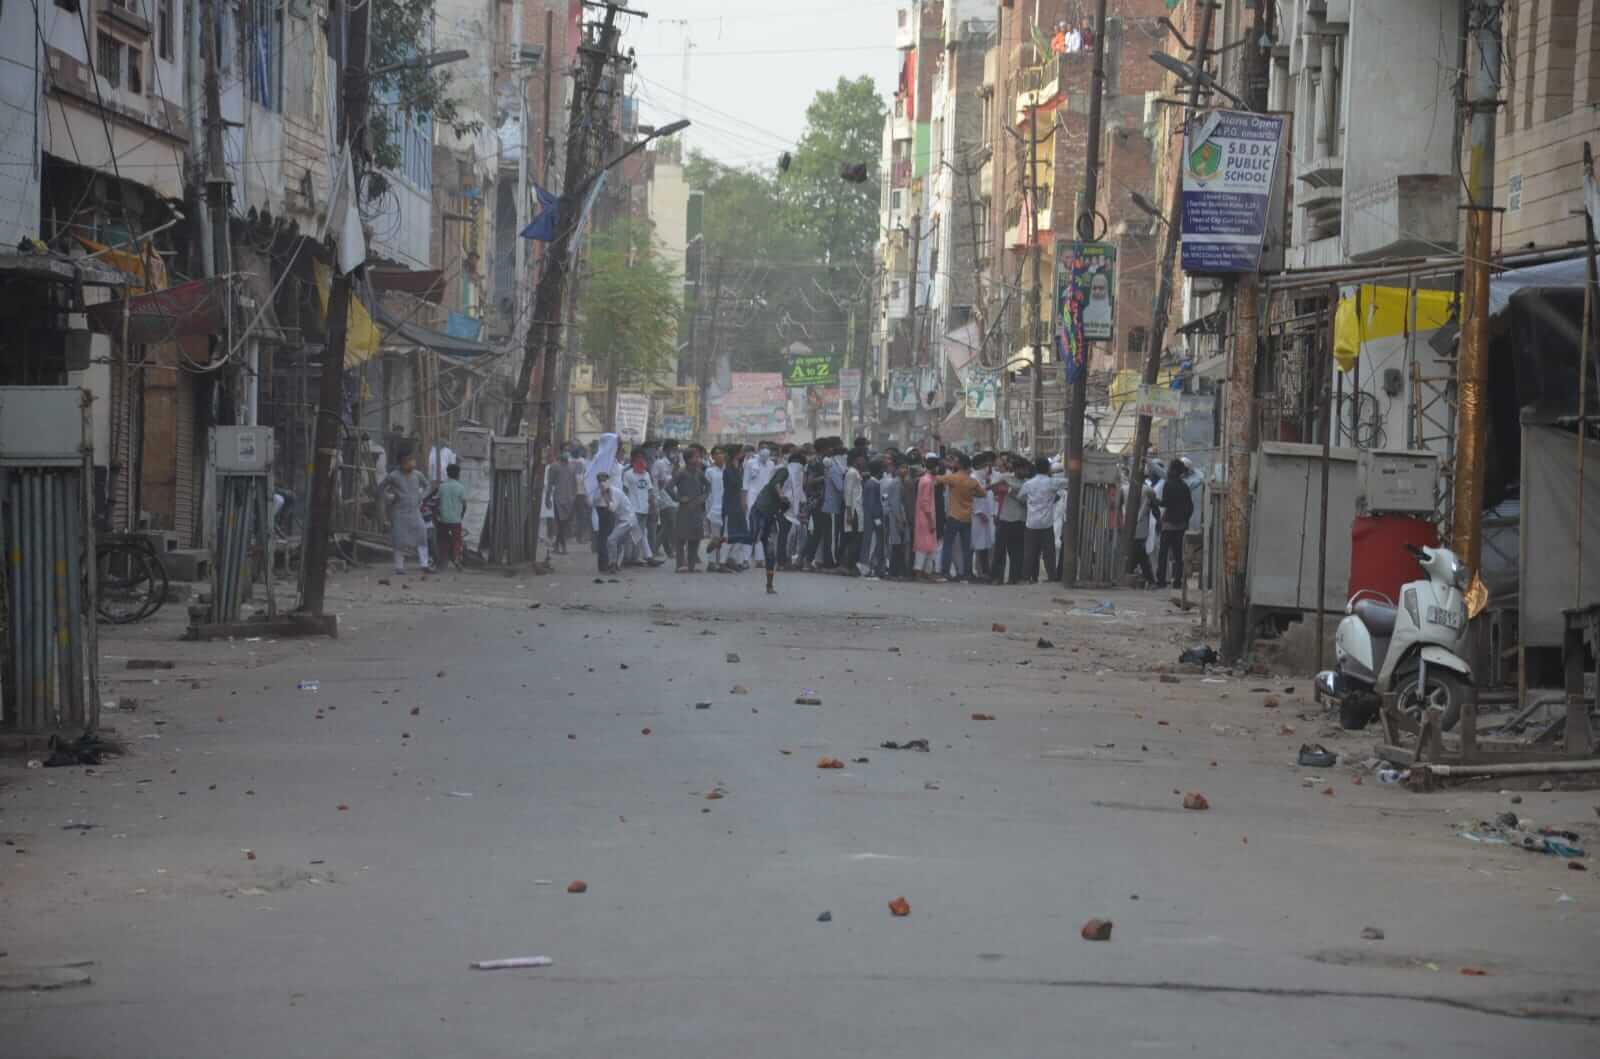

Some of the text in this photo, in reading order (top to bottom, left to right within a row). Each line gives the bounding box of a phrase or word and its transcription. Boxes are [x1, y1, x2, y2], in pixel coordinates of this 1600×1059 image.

[1251, 118, 1278, 129] Open
[1226, 156, 1270, 170] PUBLIC
[1224, 170, 1267, 183] SCHOOL
[791, 365, 805, 378] A
[816, 363, 829, 376] Z
